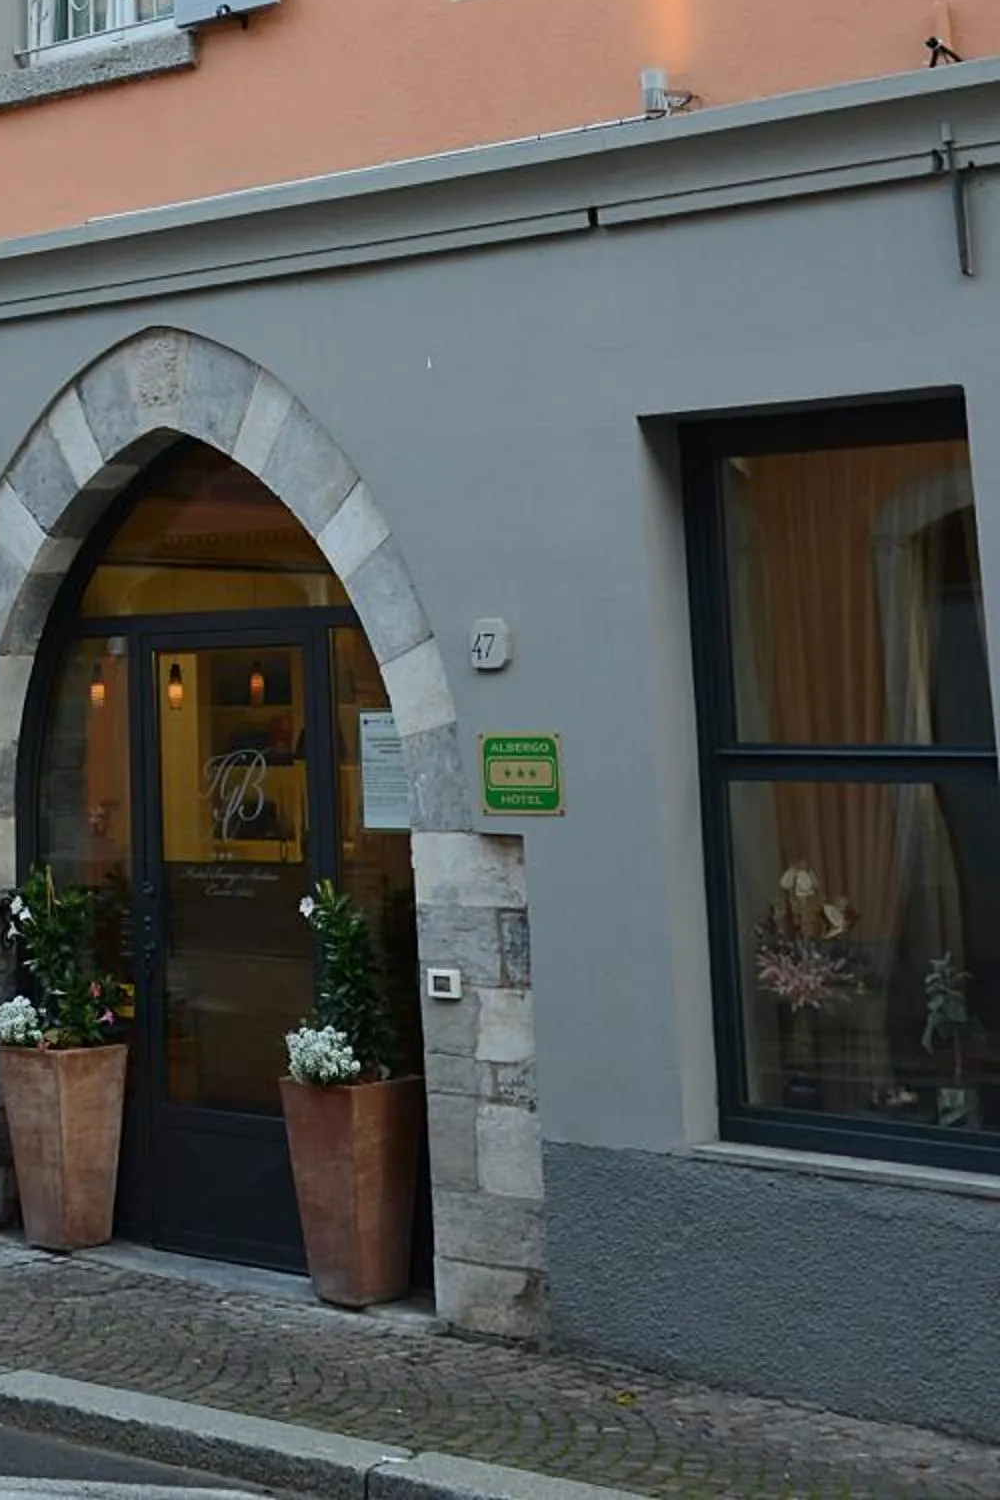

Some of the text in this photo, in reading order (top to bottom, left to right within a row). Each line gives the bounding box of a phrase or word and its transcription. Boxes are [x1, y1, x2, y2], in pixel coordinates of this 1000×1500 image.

[471, 632, 496, 660] 47
[490, 741, 550, 754] ALBERGO
[500, 793, 544, 805] HOTEL
